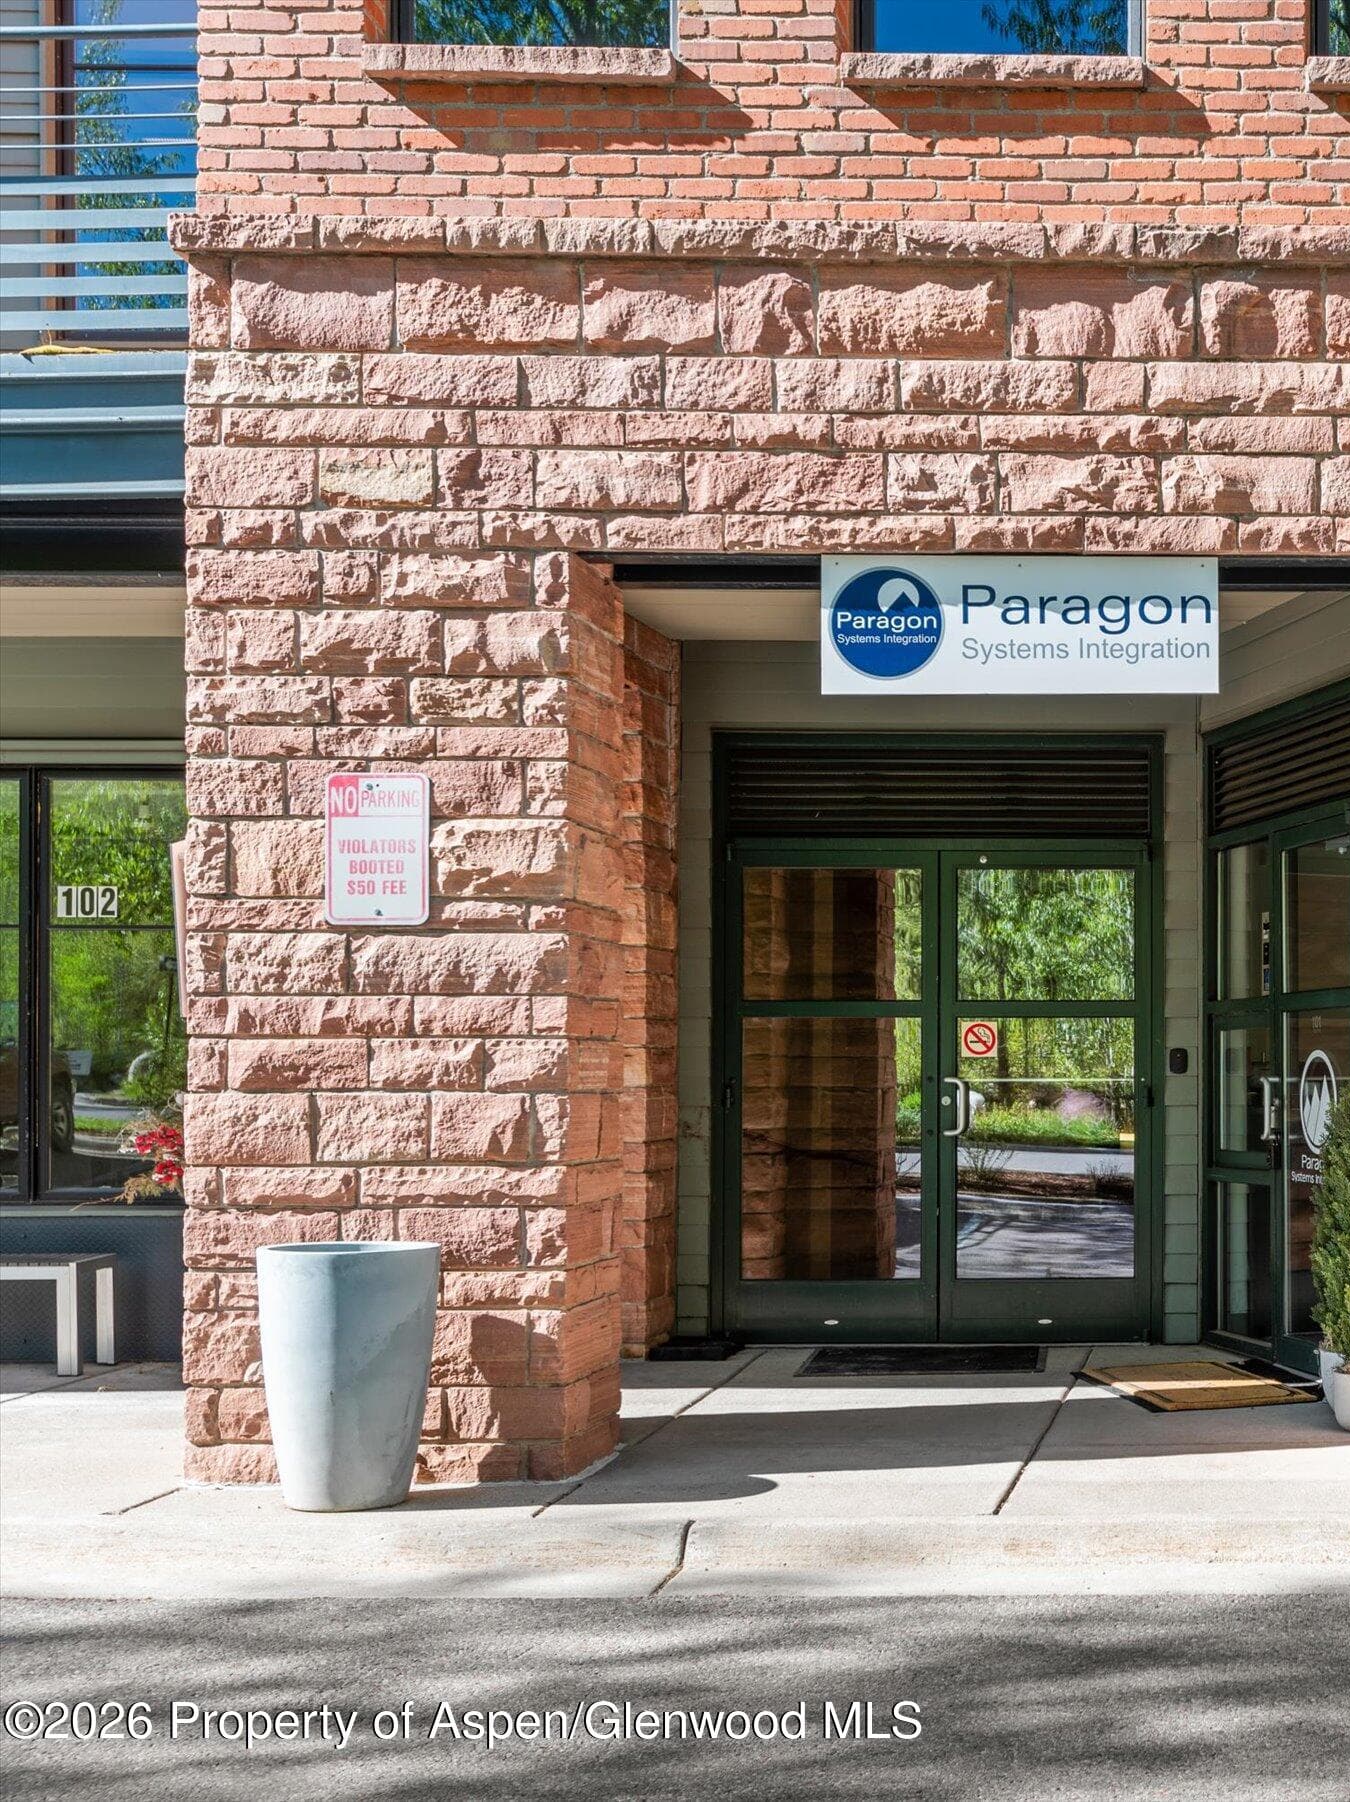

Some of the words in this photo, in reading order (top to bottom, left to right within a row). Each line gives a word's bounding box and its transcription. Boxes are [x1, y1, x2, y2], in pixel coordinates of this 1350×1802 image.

[961, 584, 1212, 635] Paragon
[836, 611, 938, 633] Paragon
[837, 633, 881, 646] Systems
[883, 633, 937, 646] Integration
[961, 637, 1069, 665] Systems
[1079, 637, 1210, 665] Integration
[330, 785, 357, 814] NO
[361, 790, 419, 808] PARKING
[338, 838, 416, 854] VIOLATORS
[349, 859, 404, 875] BOOTED
[347, 880, 376, 895] $50
[382, 880, 407, 895] FEE
[62, 887, 116, 917] 102
